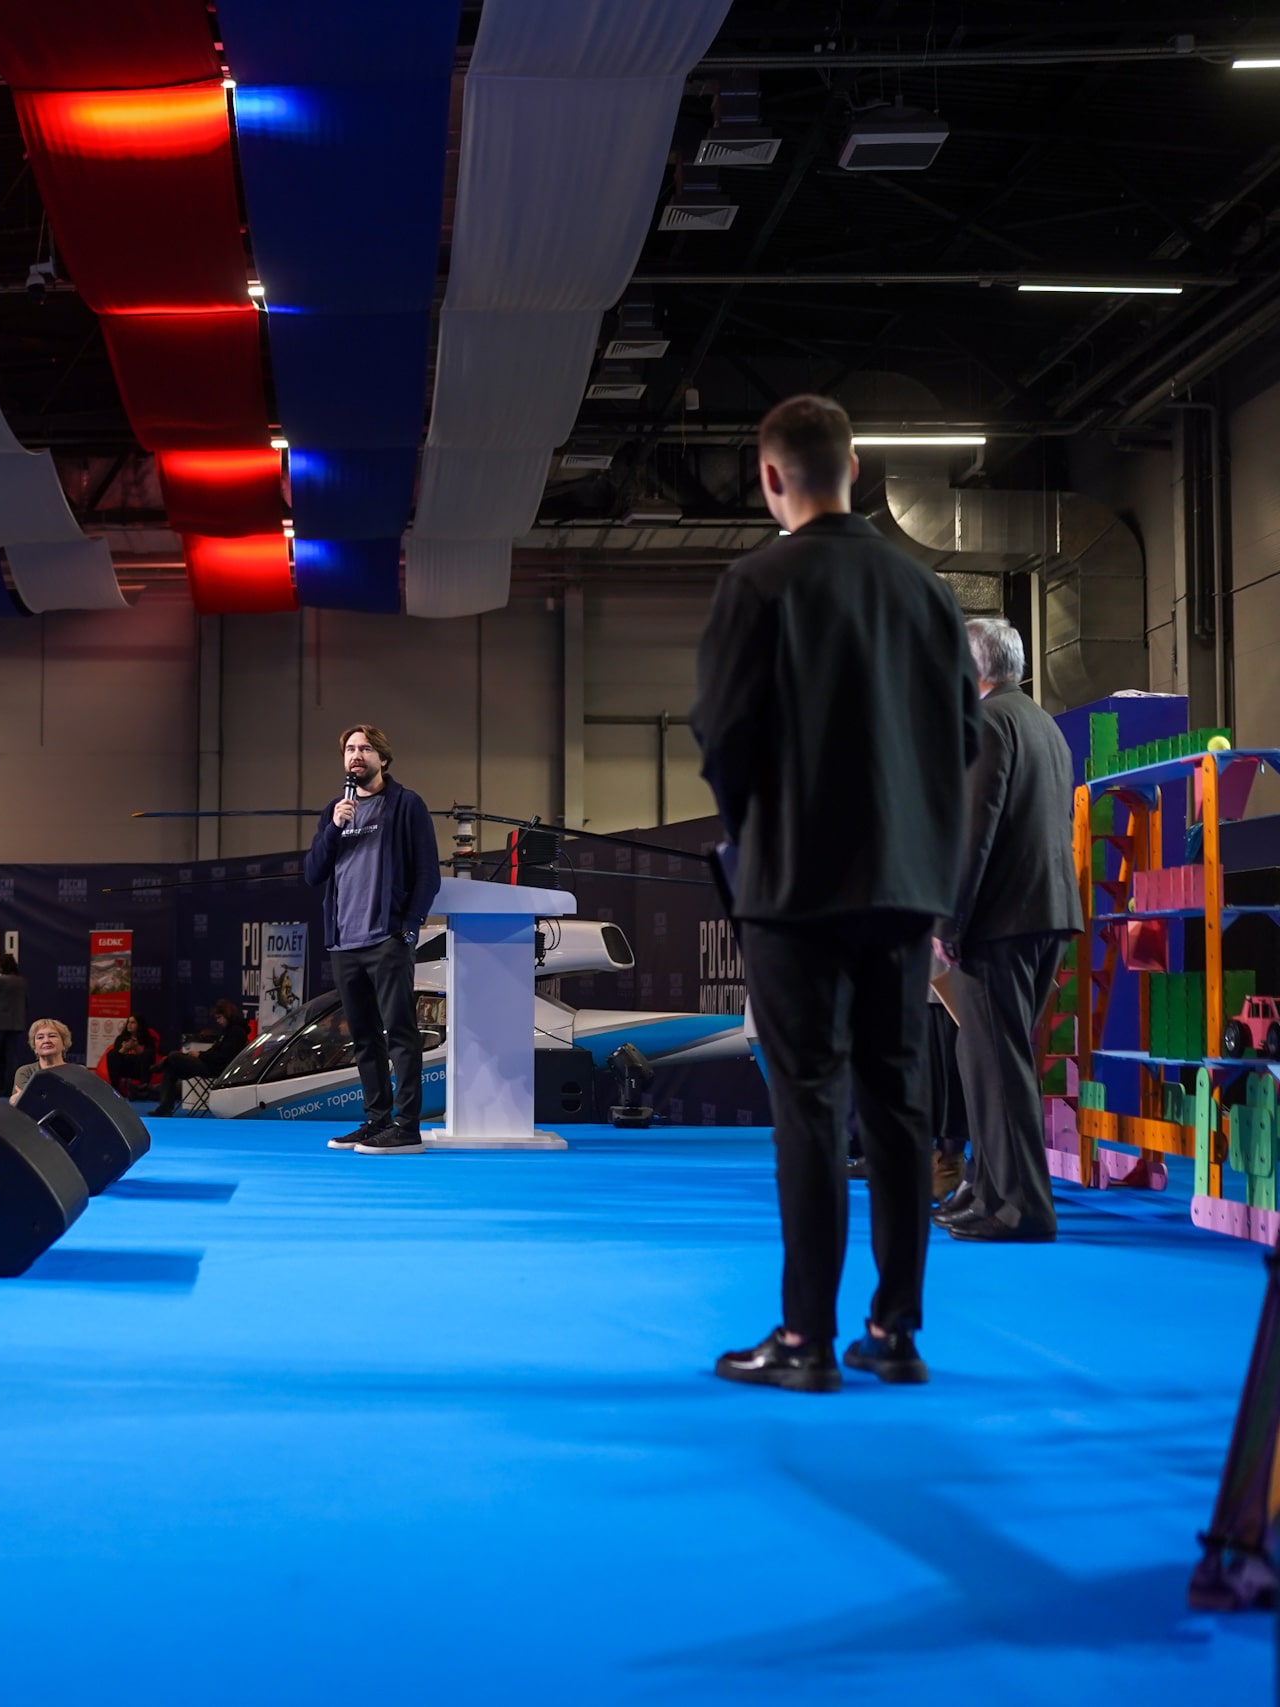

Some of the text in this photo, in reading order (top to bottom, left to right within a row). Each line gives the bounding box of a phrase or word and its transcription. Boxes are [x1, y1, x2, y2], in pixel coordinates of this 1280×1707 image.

[267, 931, 303, 951] ПОЛЁТ
[699, 919, 746, 979] РОССИ
[277, 1101, 324, 1120] Торжок-
[327, 1089, 365, 1109] город
